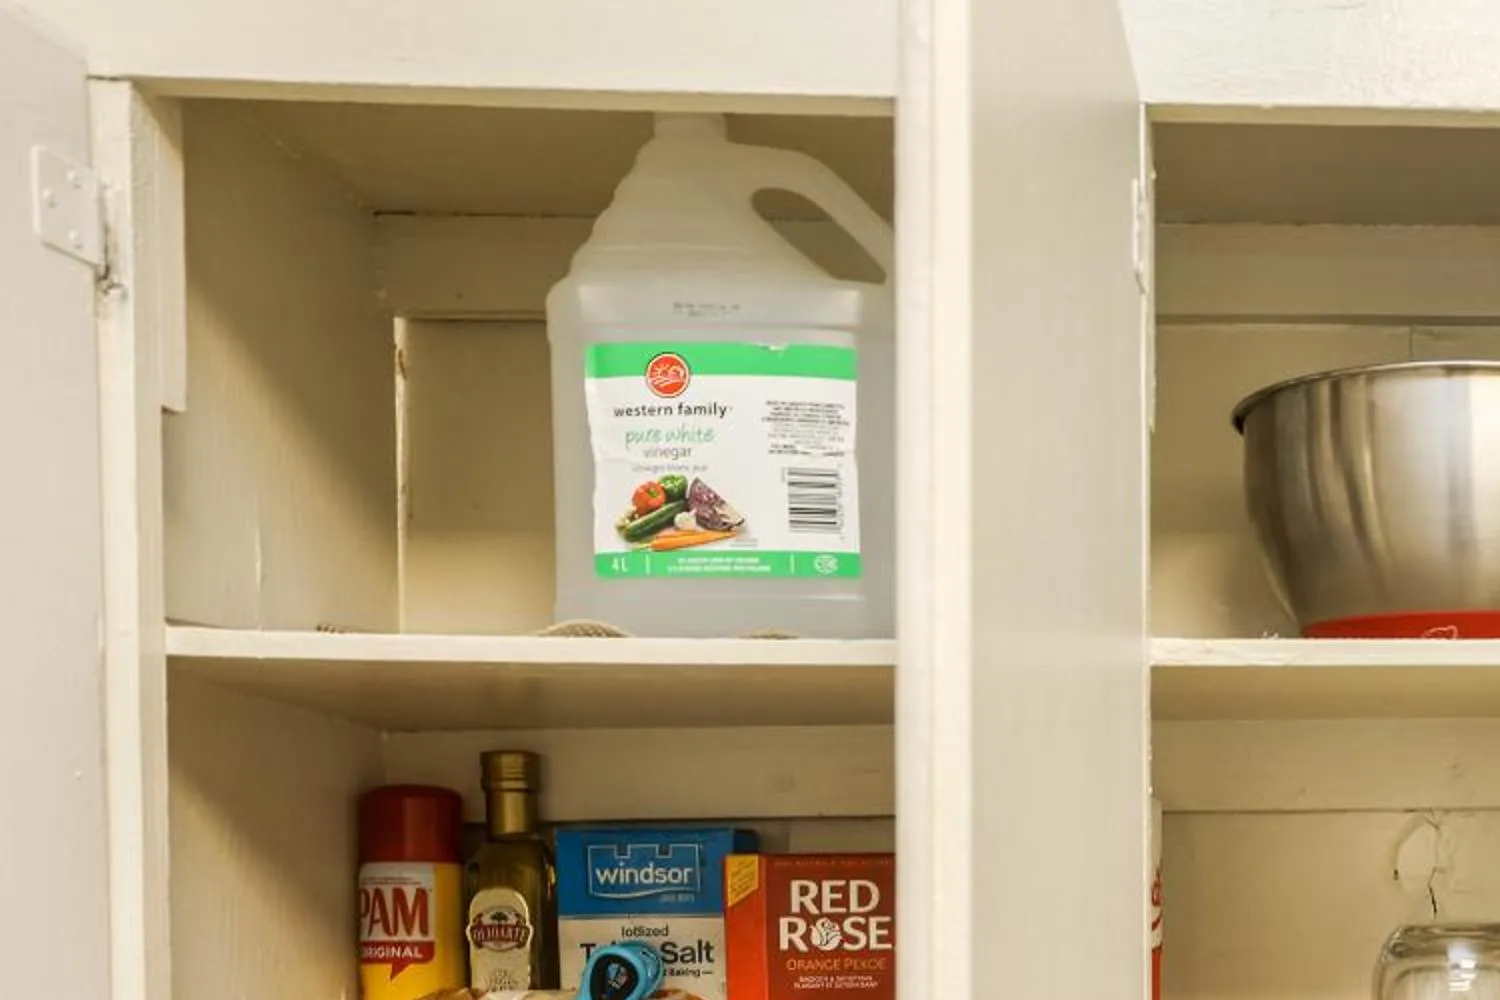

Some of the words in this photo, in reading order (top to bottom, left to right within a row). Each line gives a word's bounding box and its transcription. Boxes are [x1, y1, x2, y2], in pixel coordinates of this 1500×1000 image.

[613, 403, 674, 417] western
[677, 401, 728, 419] family
[624, 427, 662, 451] pure
[664, 421, 718, 443] white
[641, 445, 692, 461] vinegar
[595, 860, 693, 885] windsor
[790, 878, 880, 915] RED
[357, 887, 429, 937] PAM
[779, 916, 893, 952] ROSE
[660, 939, 715, 964] Salt
[786, 957, 841, 972] ORANGE
